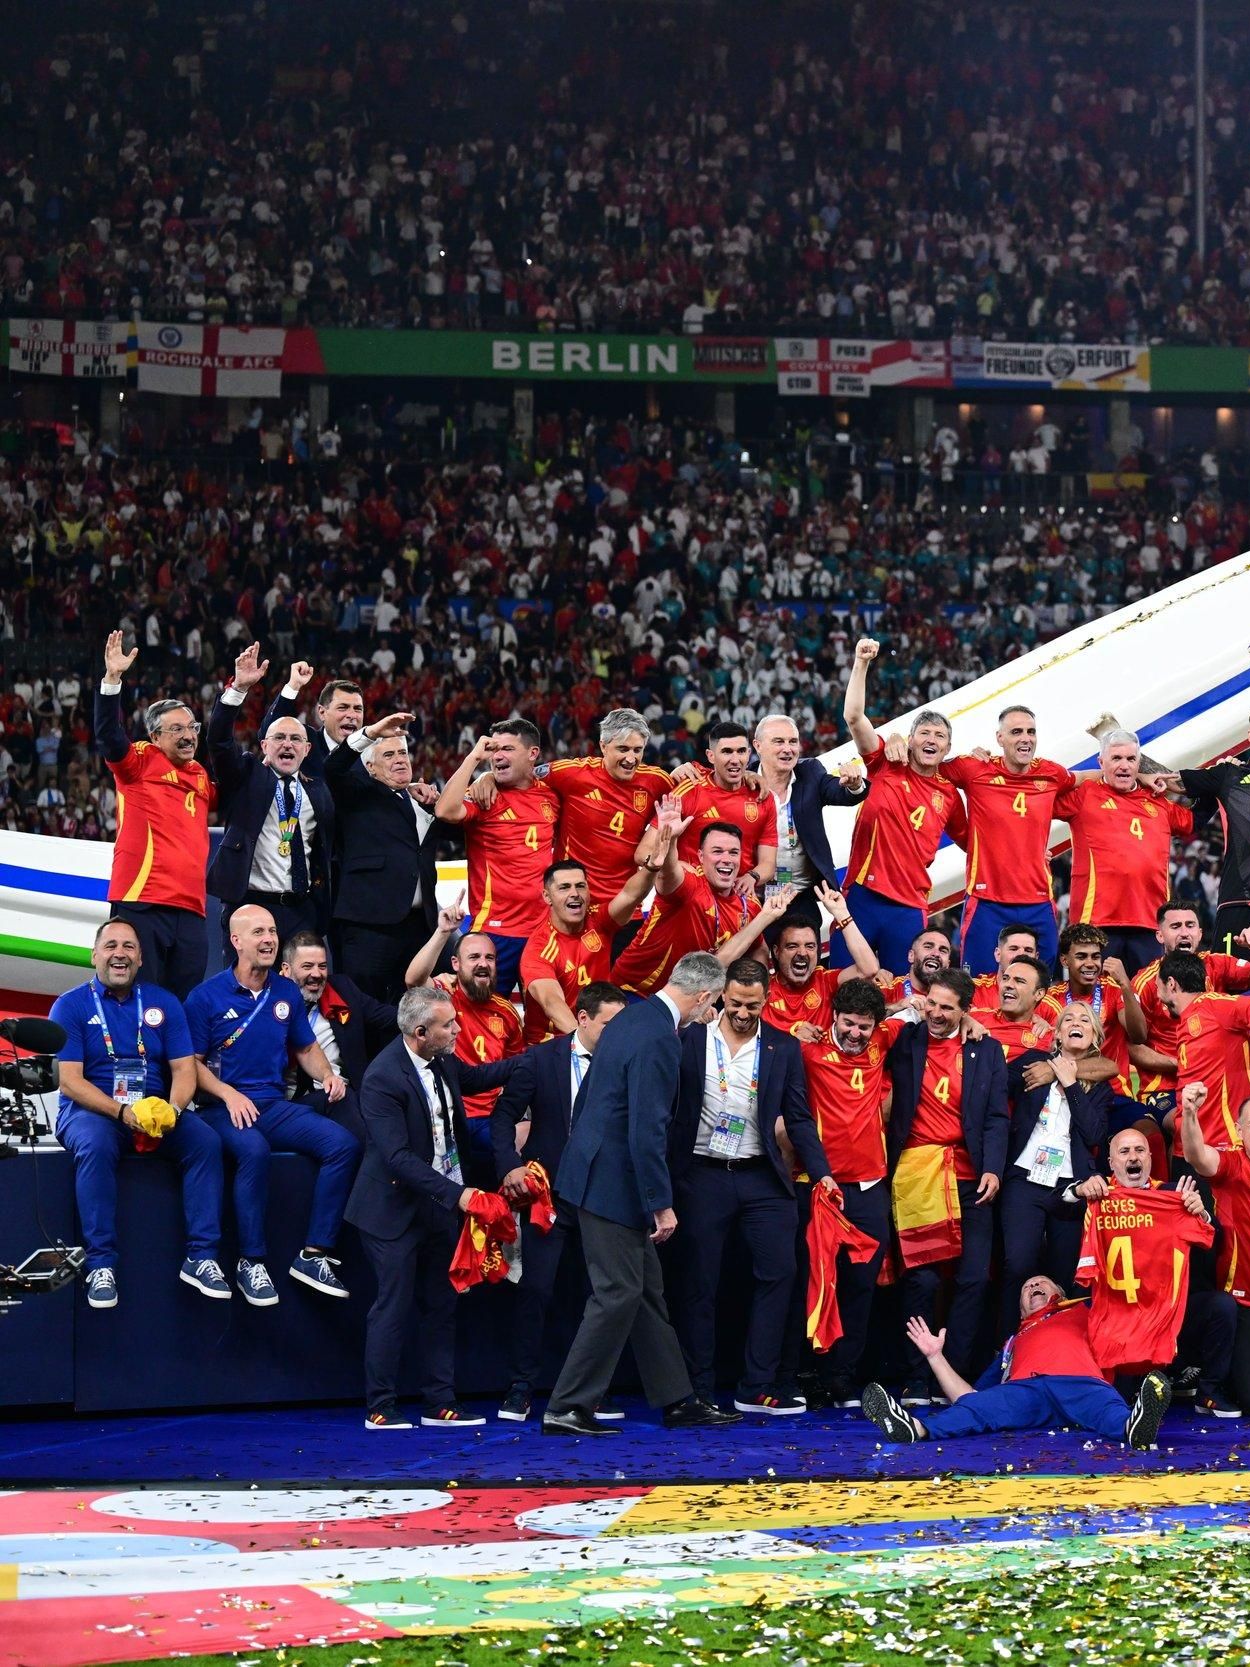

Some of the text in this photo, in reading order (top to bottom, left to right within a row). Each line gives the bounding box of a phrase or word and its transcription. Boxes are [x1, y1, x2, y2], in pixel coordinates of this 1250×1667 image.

[145, 351, 275, 369] ROCHDALE AFC
[492, 340, 677, 373] BERLIN
[788, 362, 859, 371] COVENTRY
[986, 358, 1043, 375] FREUNDE
[1077, 349, 1131, 368] ERFURT
[184, 791, 196, 817] 4
[1012, 792, 1028, 817] 4
[609, 811, 625, 837] 4
[909, 805, 926, 831] 4
[1129, 818, 1144, 840] 4
[525, 826, 539, 851] 4
[1223, 933, 1232, 956] 1
[577, 964, 592, 985] 4
[472, 1035, 487, 1061] 4
[851, 1068, 865, 1094] 4
[933, 1077, 950, 1105] 4
[1101, 1199, 1136, 1213] REYES
[1104, 1213, 1154, 1230] EUROPA
[1107, 1235, 1141, 1303] 4
